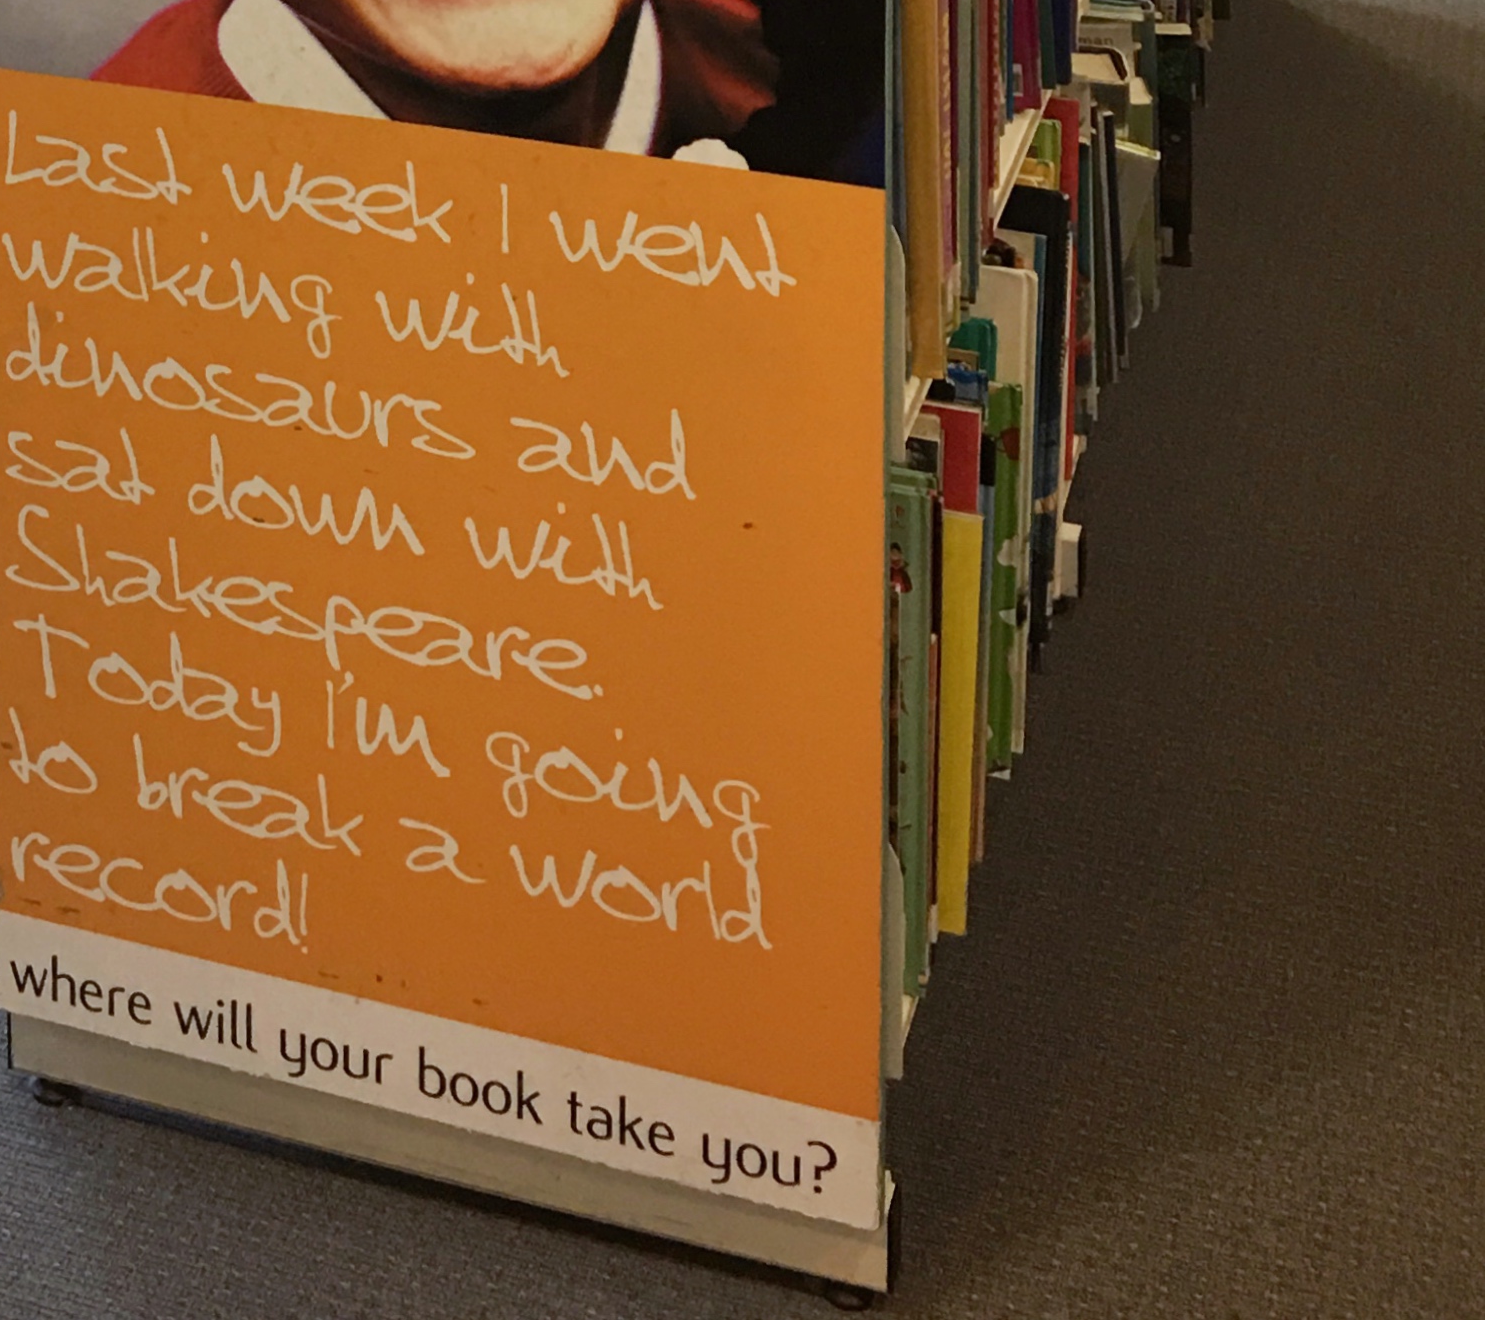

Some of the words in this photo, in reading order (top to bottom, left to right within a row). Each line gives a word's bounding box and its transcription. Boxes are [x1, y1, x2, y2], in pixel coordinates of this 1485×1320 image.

[5, 110, 192, 205] Last
[222, 161, 454, 244] week
[499, 183, 510, 254] I
[549, 211, 797, 297] went
[1, 228, 341, 359] walking
[374, 273, 569, 377] with
[5, 301, 477, 460] dinosaurs
[510, 409, 697, 501] and
[5, 428, 156, 505] sat
[187, 434, 425, 556] down
[464, 501, 663, 610] with
[5, 503, 603, 700] Shakespeare.
[9, 708, 98, 794] to
[133, 734, 364, 856] break
[399, 818, 486, 884] a
[509, 844, 772, 950] world
[13, 613, 282, 758] Today
[326, 671, 451, 778] I'm
[486, 729, 771, 863] going
[11, 831, 309, 954] record!
[9, 954, 153, 1027] where
[173, 998, 258, 1054] will
[278, 1025, 395, 1084] your
[417, 1045, 544, 1125] book
[566, 1091, 676, 1158] take
[701, 1134, 838, 1201] you?
